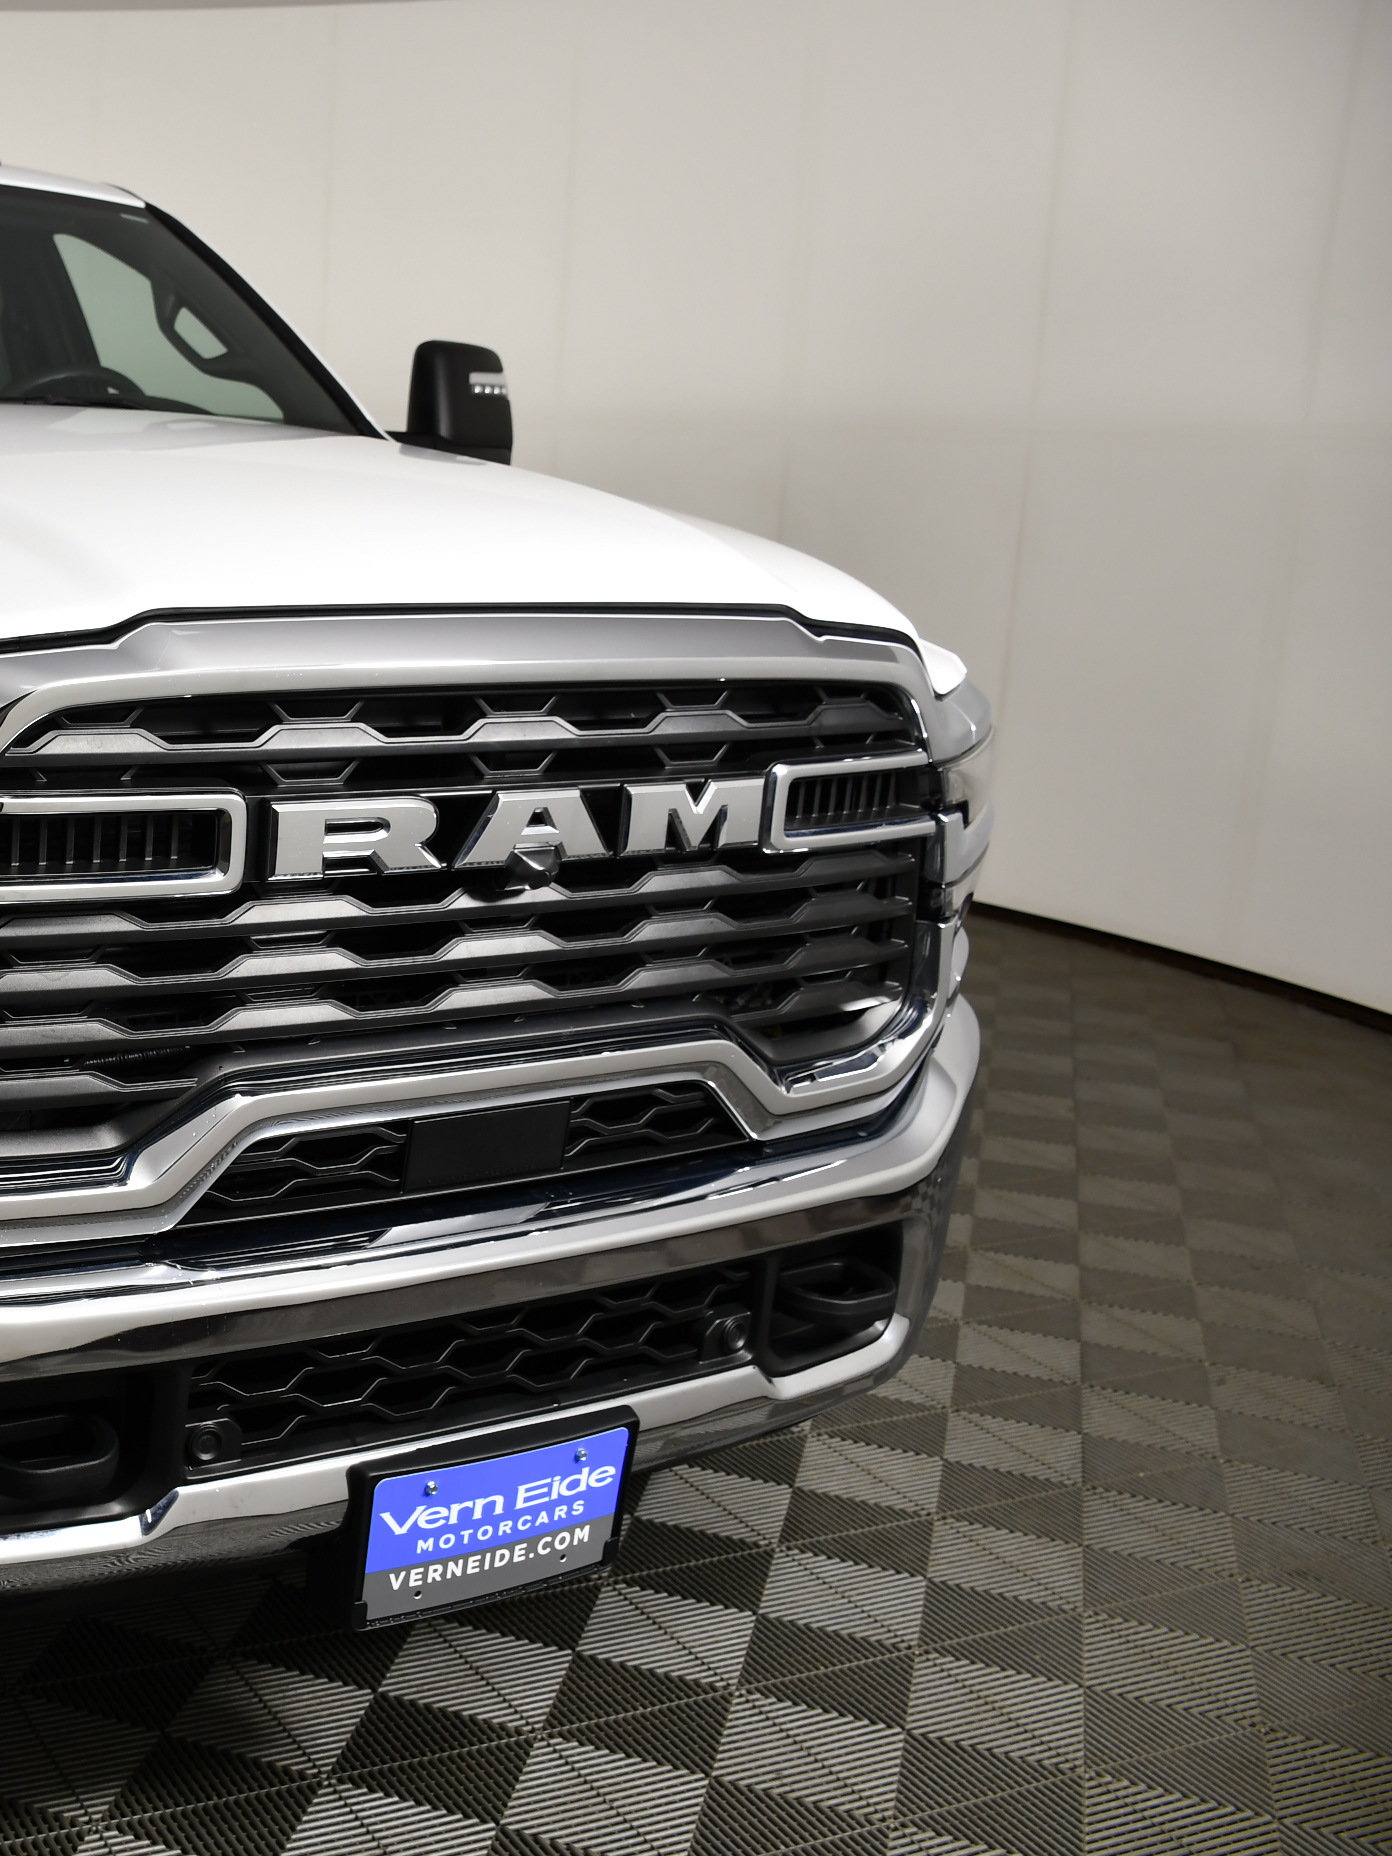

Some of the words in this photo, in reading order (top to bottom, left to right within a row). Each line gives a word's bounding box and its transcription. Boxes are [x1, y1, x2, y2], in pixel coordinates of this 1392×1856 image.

[268, 779, 765, 880] RAM
[379, 1494, 505, 1535] Vern
[514, 1465, 617, 1510] Eide
[416, 1500, 586, 1554] MOTORCARS
[389, 1525, 591, 1591] VERNEIDE.COM
